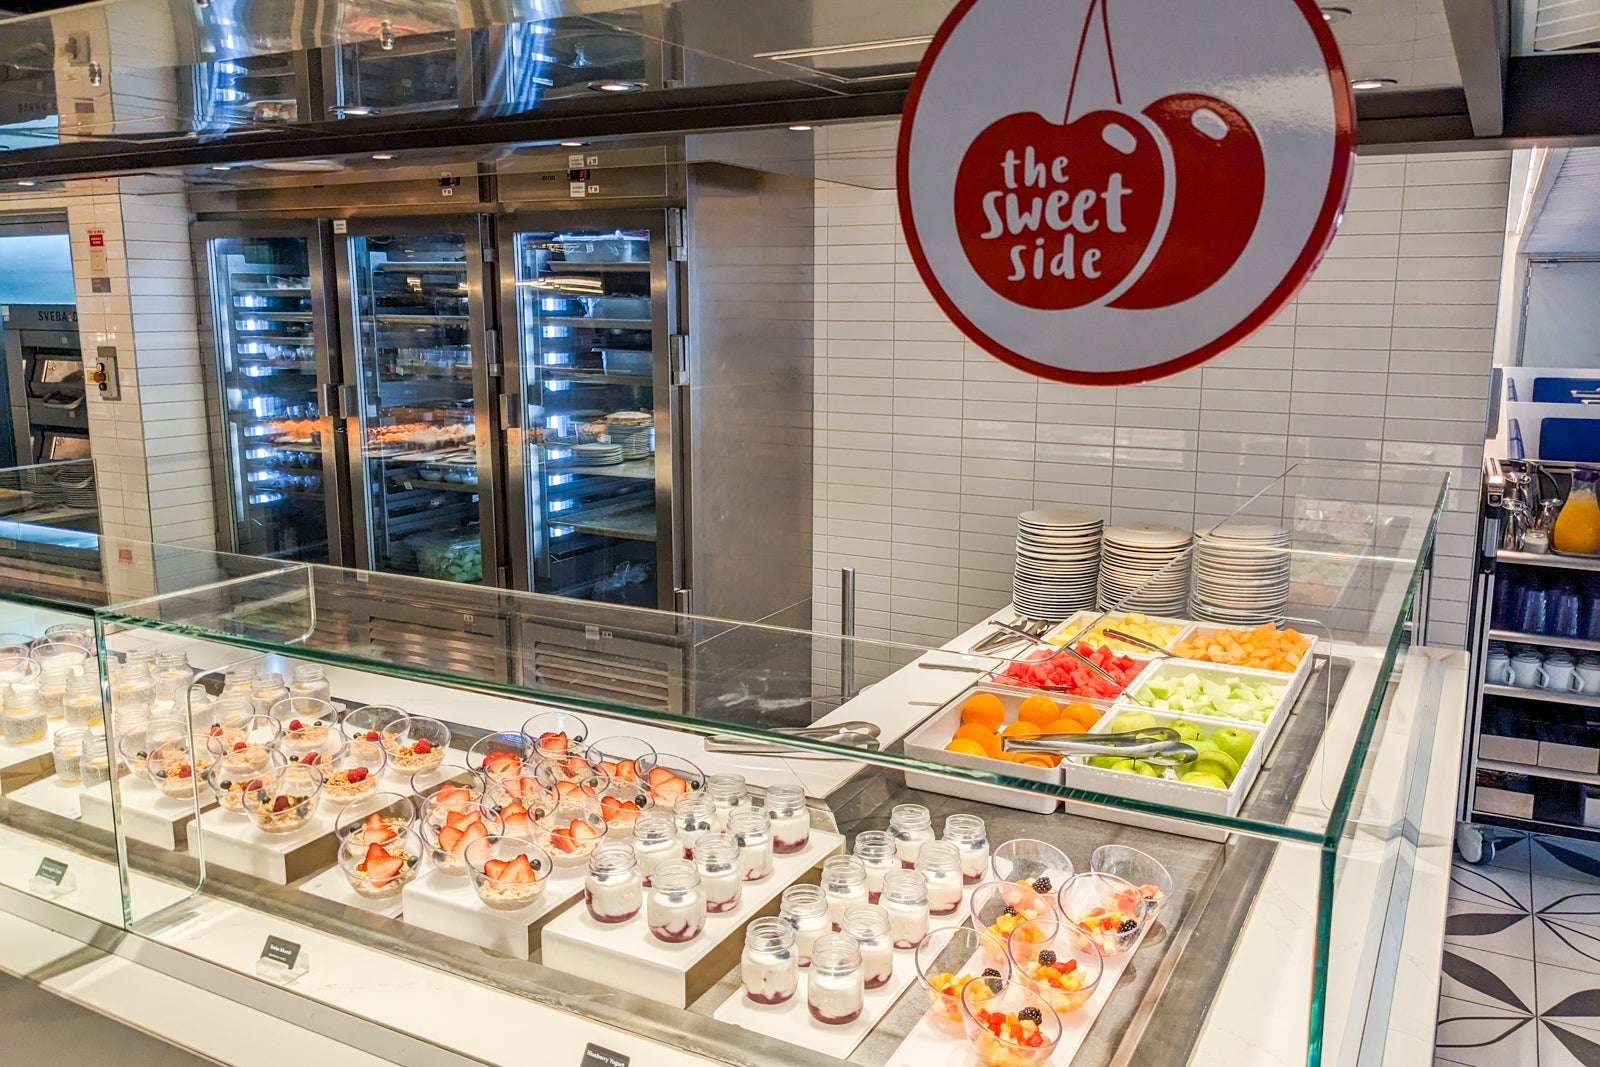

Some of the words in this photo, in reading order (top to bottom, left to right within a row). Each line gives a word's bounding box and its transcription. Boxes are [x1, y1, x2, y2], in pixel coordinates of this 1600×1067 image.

[1001, 146, 1069, 189] the
[980, 172, 1133, 239] sweet
[1007, 233, 1101, 282] side
[38, 311, 67, 322] SVEBA
